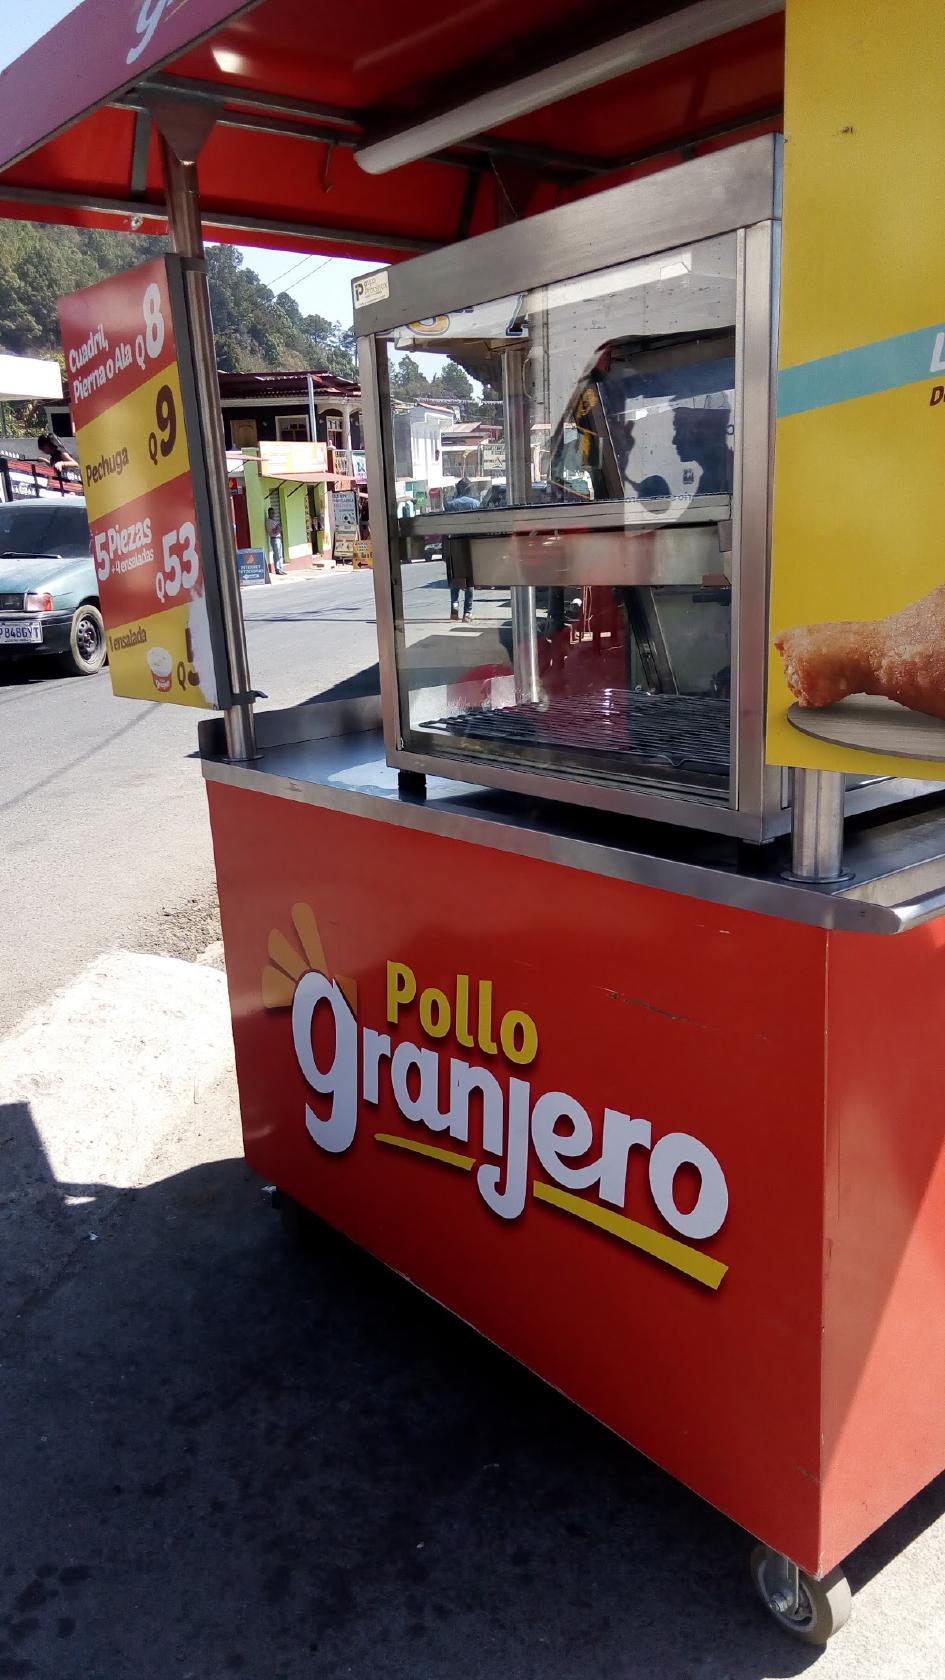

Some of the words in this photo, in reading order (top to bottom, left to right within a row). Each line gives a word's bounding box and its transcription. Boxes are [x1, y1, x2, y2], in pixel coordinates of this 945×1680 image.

[69, 323, 108, 373] Cuadril,
[73, 365, 106, 404] Pierna
[106, 359, 114, 379] o
[115, 342, 133, 374] Ala
[86, 447, 129, 487] Pechuga
[107, 518, 152, 560] Piezas
[114, 626, 148, 651] ensalada
[386, 960, 538, 1065] Pollo
[291, 969, 729, 1240] granjero
